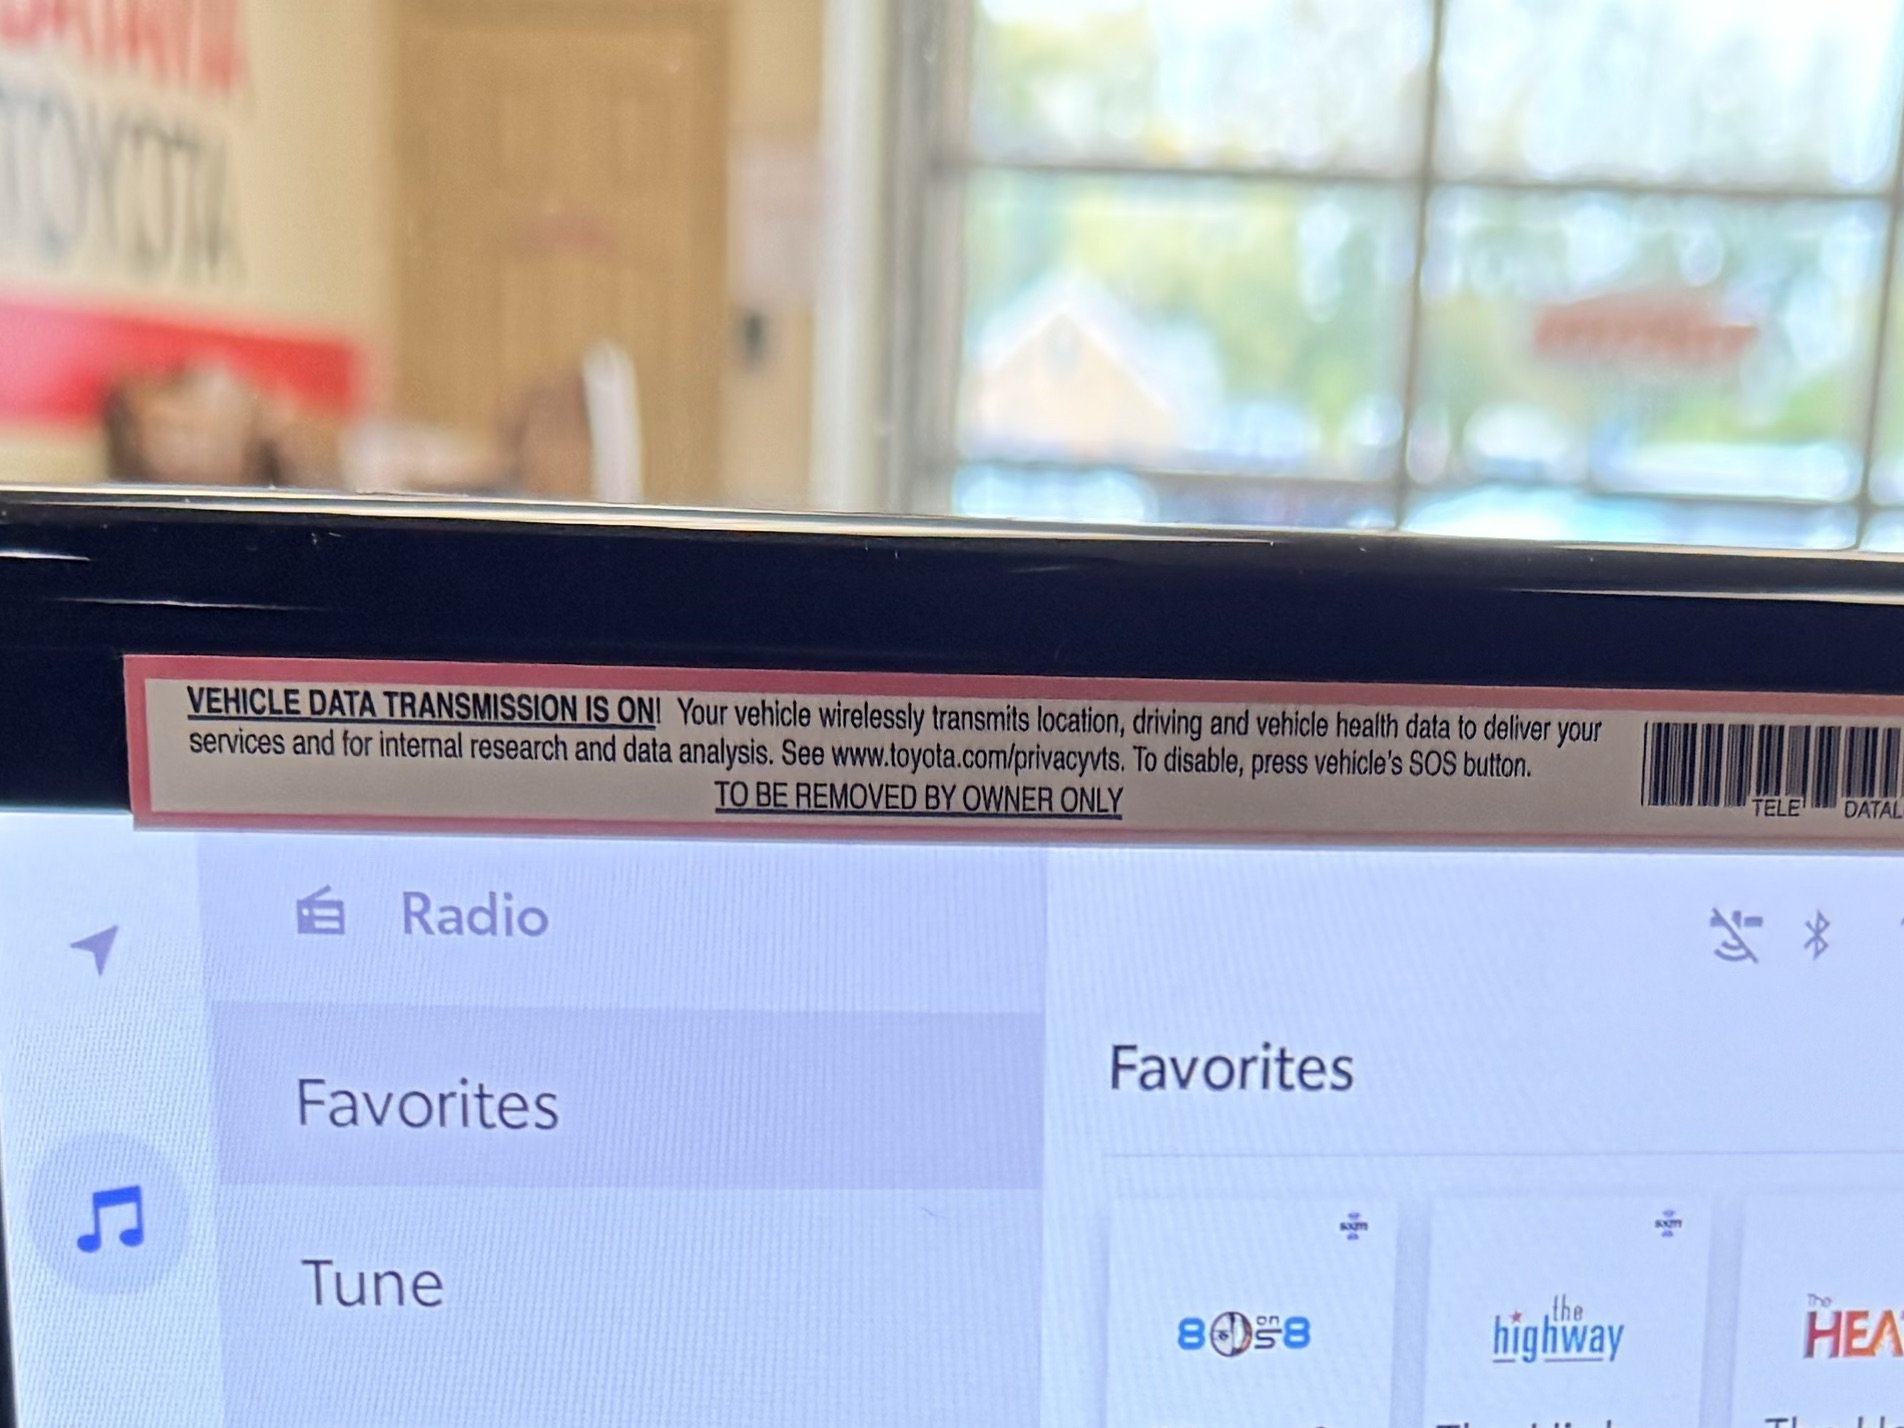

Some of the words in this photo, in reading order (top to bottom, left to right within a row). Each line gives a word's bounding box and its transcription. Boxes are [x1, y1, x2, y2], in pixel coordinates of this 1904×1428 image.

[188, 686, 301, 715] VEHICLE
[309, 688, 377, 718] DATA
[382, 690, 578, 723] TRANSMISSION
[586, 695, 610, 723] IS
[617, 695, 662, 724] ON!
[677, 697, 728, 726] Your
[735, 699, 811, 728] vehicle
[818, 701, 924, 737] wirelessly
[932, 703, 1030, 733] transmits
[1037, 705, 1125, 738] location,
[1133, 707, 1202, 741] driving
[1210, 709, 1249, 736] and
[1257, 710, 1328, 737] vehicle
[1336, 711, 1398, 739] health
[1406, 713, 1450, 740] data
[1458, 714, 1477, 741] to
[1483, 714, 1552, 742] deliver
[1556, 719, 1602, 748] your
[189, 727, 286, 755] services
[292, 728, 335, 756] and
[342, 729, 373, 757] for
[379, 730, 463, 759] internal
[470, 733, 568, 761] research
[574, 734, 617, 763] and
[623, 735, 673, 763] data
[679, 737, 774, 771] analysis.
[782, 739, 825, 766] See
[1133, 745, 1157, 773] To
[1164, 746, 1244, 777] disable,
[1252, 752, 1308, 780] press
[1315, 749, 1403, 776] vehicle's
[1409, 750, 1457, 777] SOS
[1464, 751, 1532, 778] button.
[715, 781, 748, 807] TO
[757, 782, 788, 808] BE
[796, 783, 916, 811] REMOVED
[925, 784, 957, 811] BY
[963, 785, 1053, 813] OWNER
[1061, 786, 1124, 813] ONLY
[1751, 798, 1801, 818] TELE
[401, 889, 550, 939] Radio
[1109, 1041, 1356, 1094] Favorites
[296, 1076, 560, 1132] Favorites
[301, 1258, 445, 1310] Tune
[1552, 1293, 1584, 1322] the
[1493, 1313, 1626, 1364] highway
